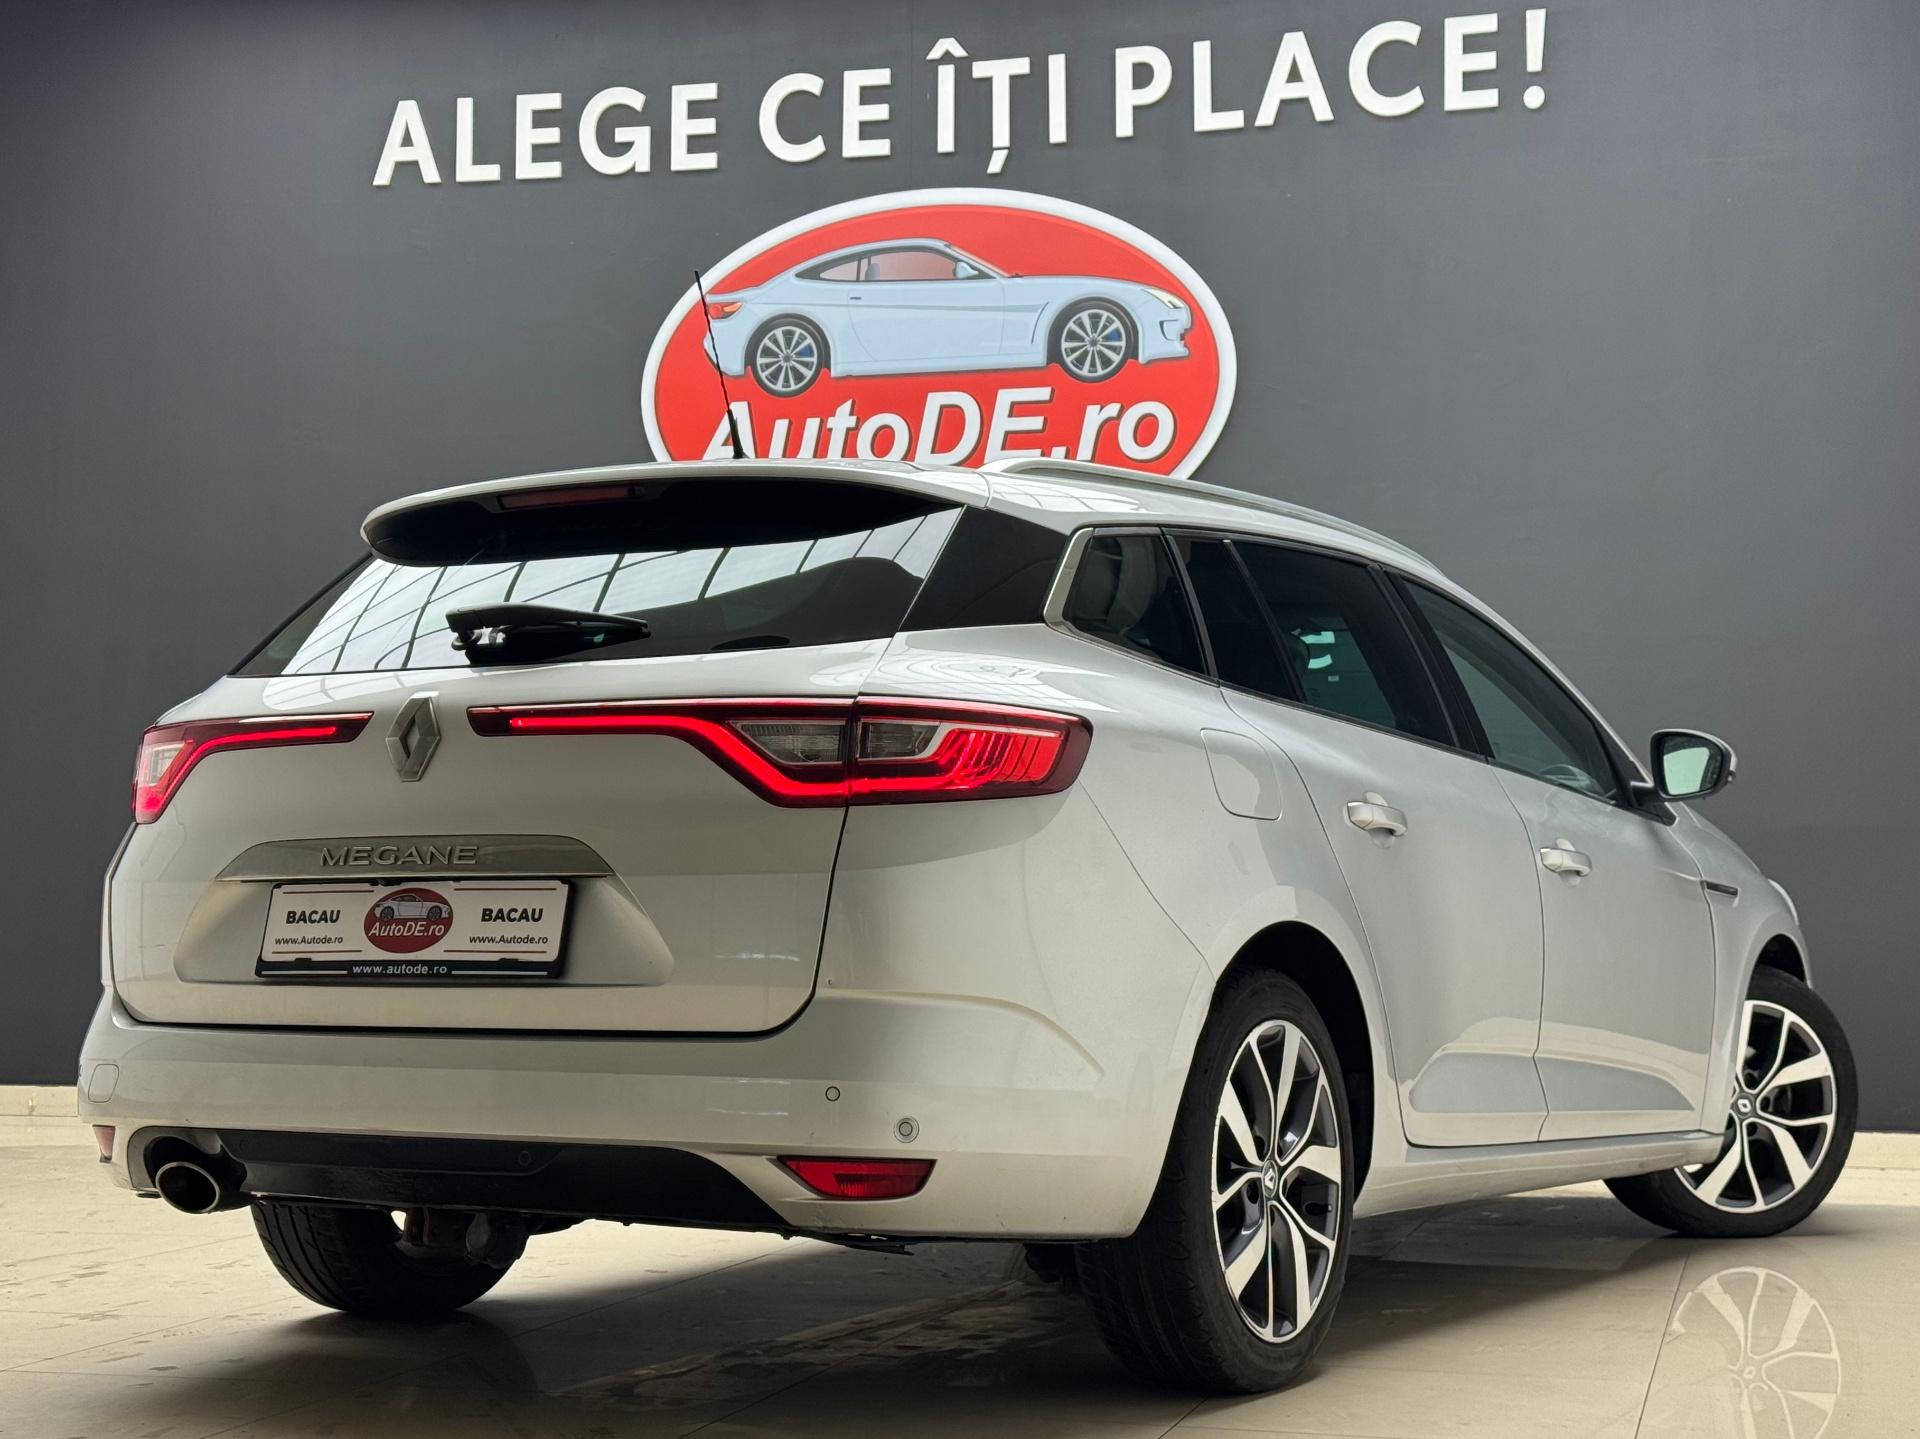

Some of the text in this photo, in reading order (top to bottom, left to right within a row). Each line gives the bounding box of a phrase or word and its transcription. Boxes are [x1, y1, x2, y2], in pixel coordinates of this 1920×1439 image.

[372, 82, 718, 187] ALEGE
[758, 67, 892, 164] CE
[1114, 8, 1547, 138] PLACE!
[319, 845, 479, 867] MEGANE
[285, 909, 341, 925] BACAU
[480, 907, 545, 923] BACAU
[368, 921, 446, 937] AutoDE.ro
[274, 935, 344, 946] www.Autode.ro
[468, 934, 549, 945] www.Autode.ro
[351, 963, 448, 975] www.autode.ro
